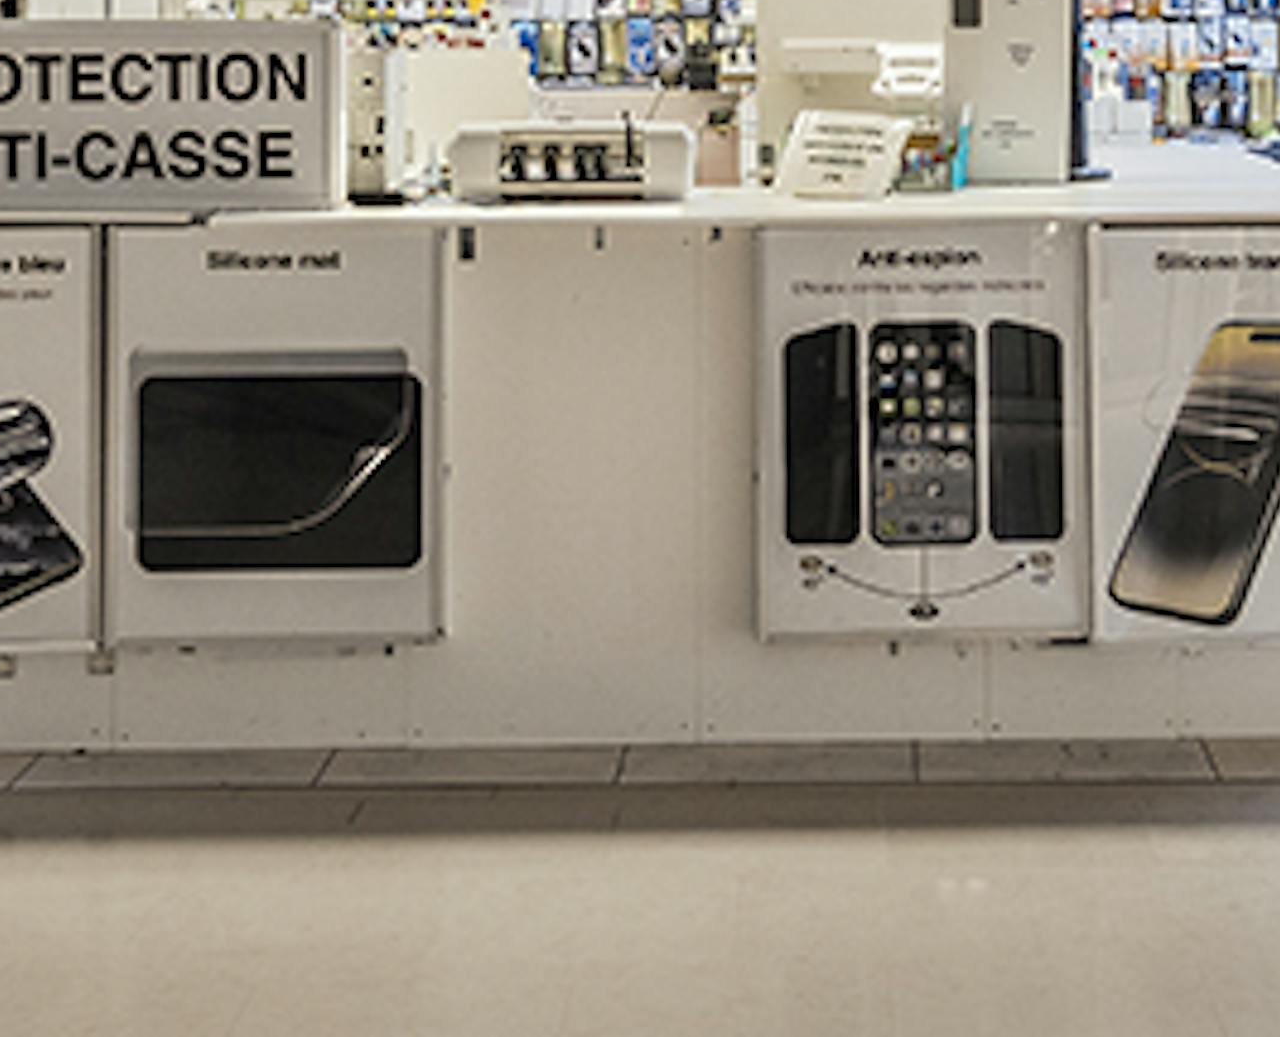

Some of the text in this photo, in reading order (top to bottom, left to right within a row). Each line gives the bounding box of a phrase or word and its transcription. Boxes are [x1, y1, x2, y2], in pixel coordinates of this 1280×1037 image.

[17, 254, 66, 275] bleu
[206, 249, 341, 270] Silicone mat
[857, 248, 982, 271] Anti-espion
[1155, 250, 1240, 272] Silicone
